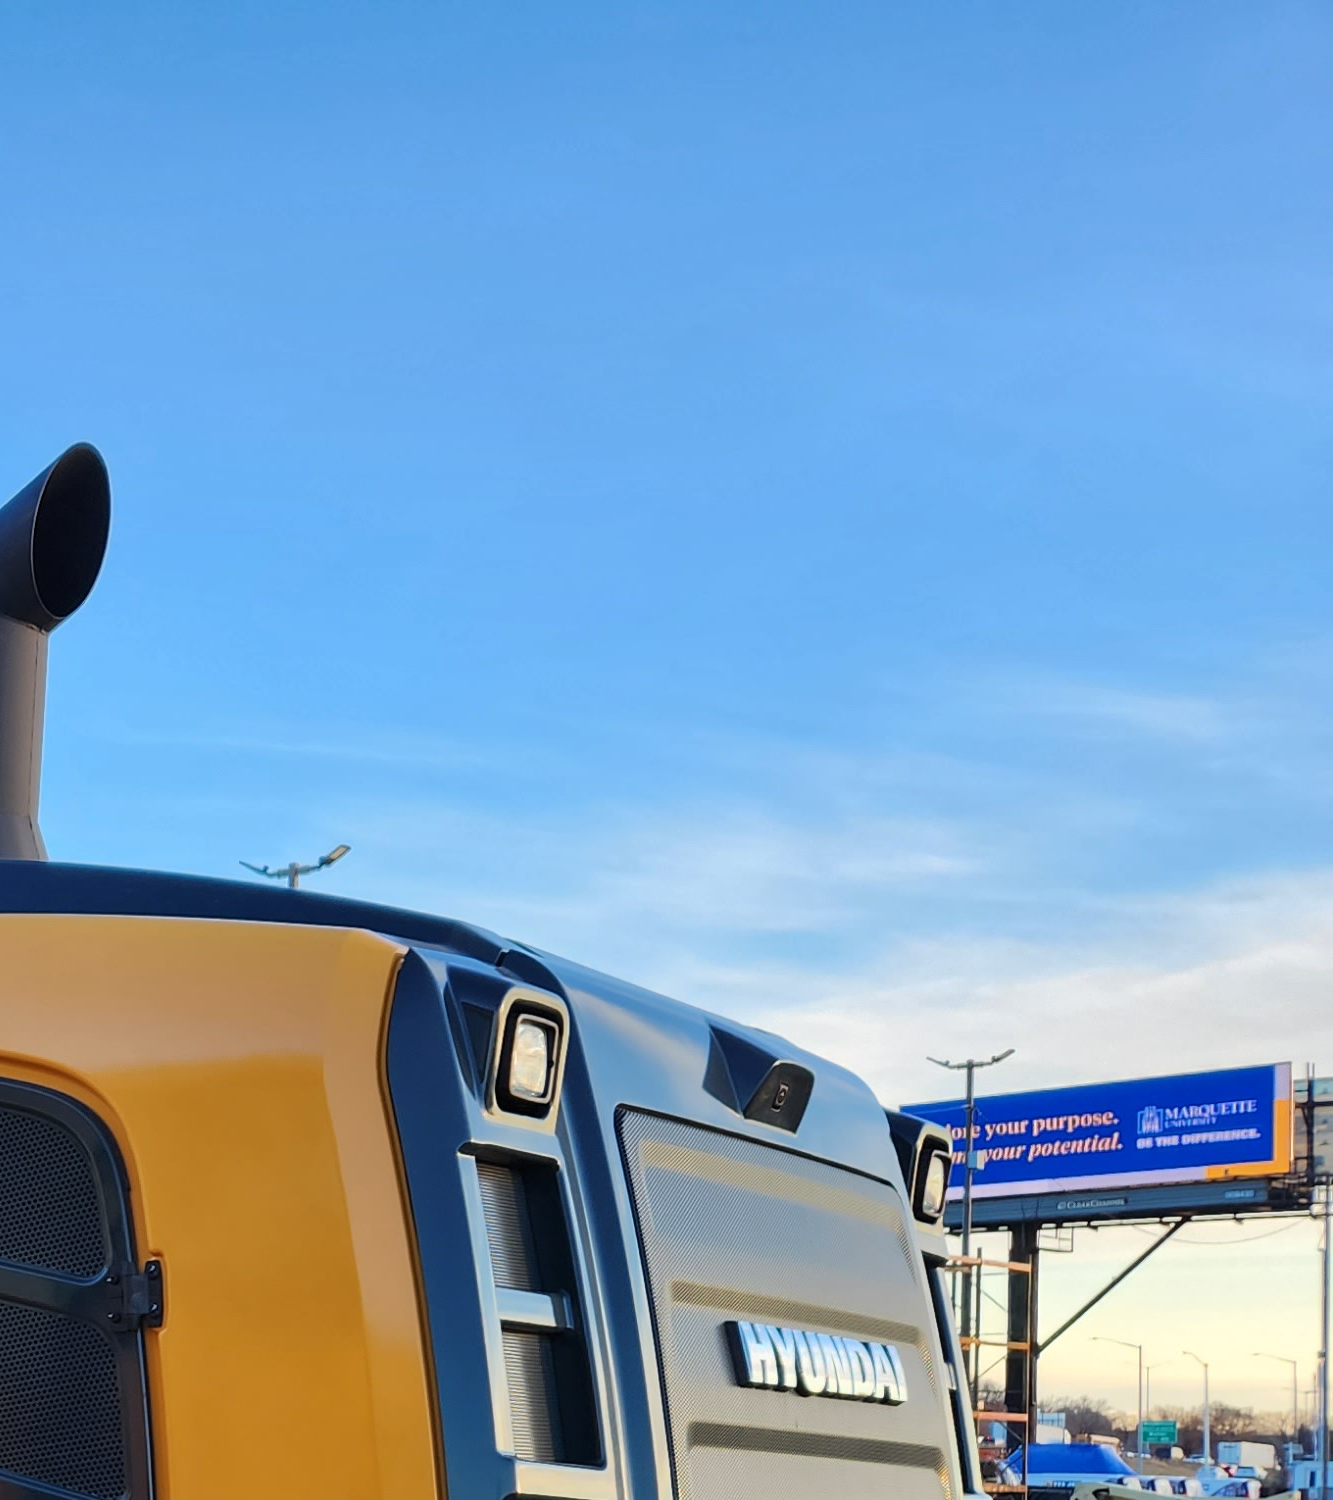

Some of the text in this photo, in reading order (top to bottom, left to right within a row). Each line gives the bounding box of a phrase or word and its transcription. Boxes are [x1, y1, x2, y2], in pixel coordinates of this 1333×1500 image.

[1165, 1099, 1257, 1120] MARQUETTE
[985, 1119, 1029, 1141] your
[1033, 1111, 1120, 1137] purpose.
[1028, 1132, 1124, 1163] potential.
[736, 1320, 909, 1403] HYUNDAI
